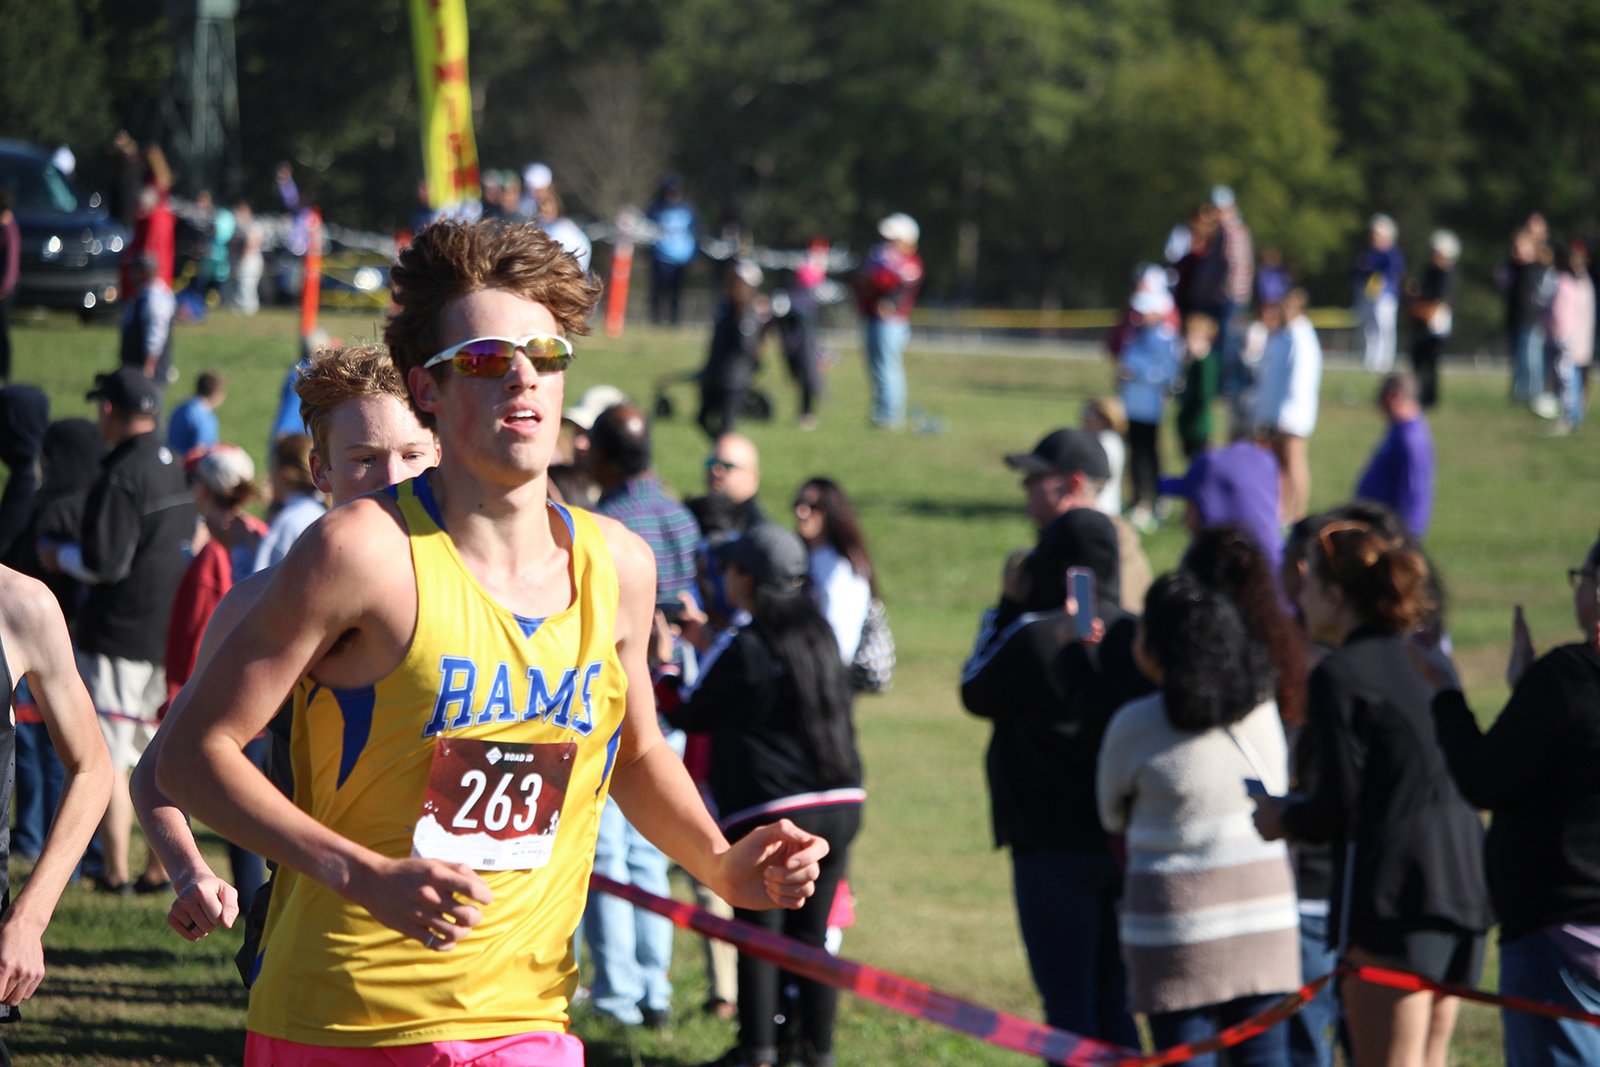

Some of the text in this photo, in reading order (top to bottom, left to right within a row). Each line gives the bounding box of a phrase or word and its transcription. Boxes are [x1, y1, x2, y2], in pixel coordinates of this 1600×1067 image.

[423, 655, 602, 737] RAMS
[504, 753, 525, 763] ROAD
[452, 769, 543, 832] 263
